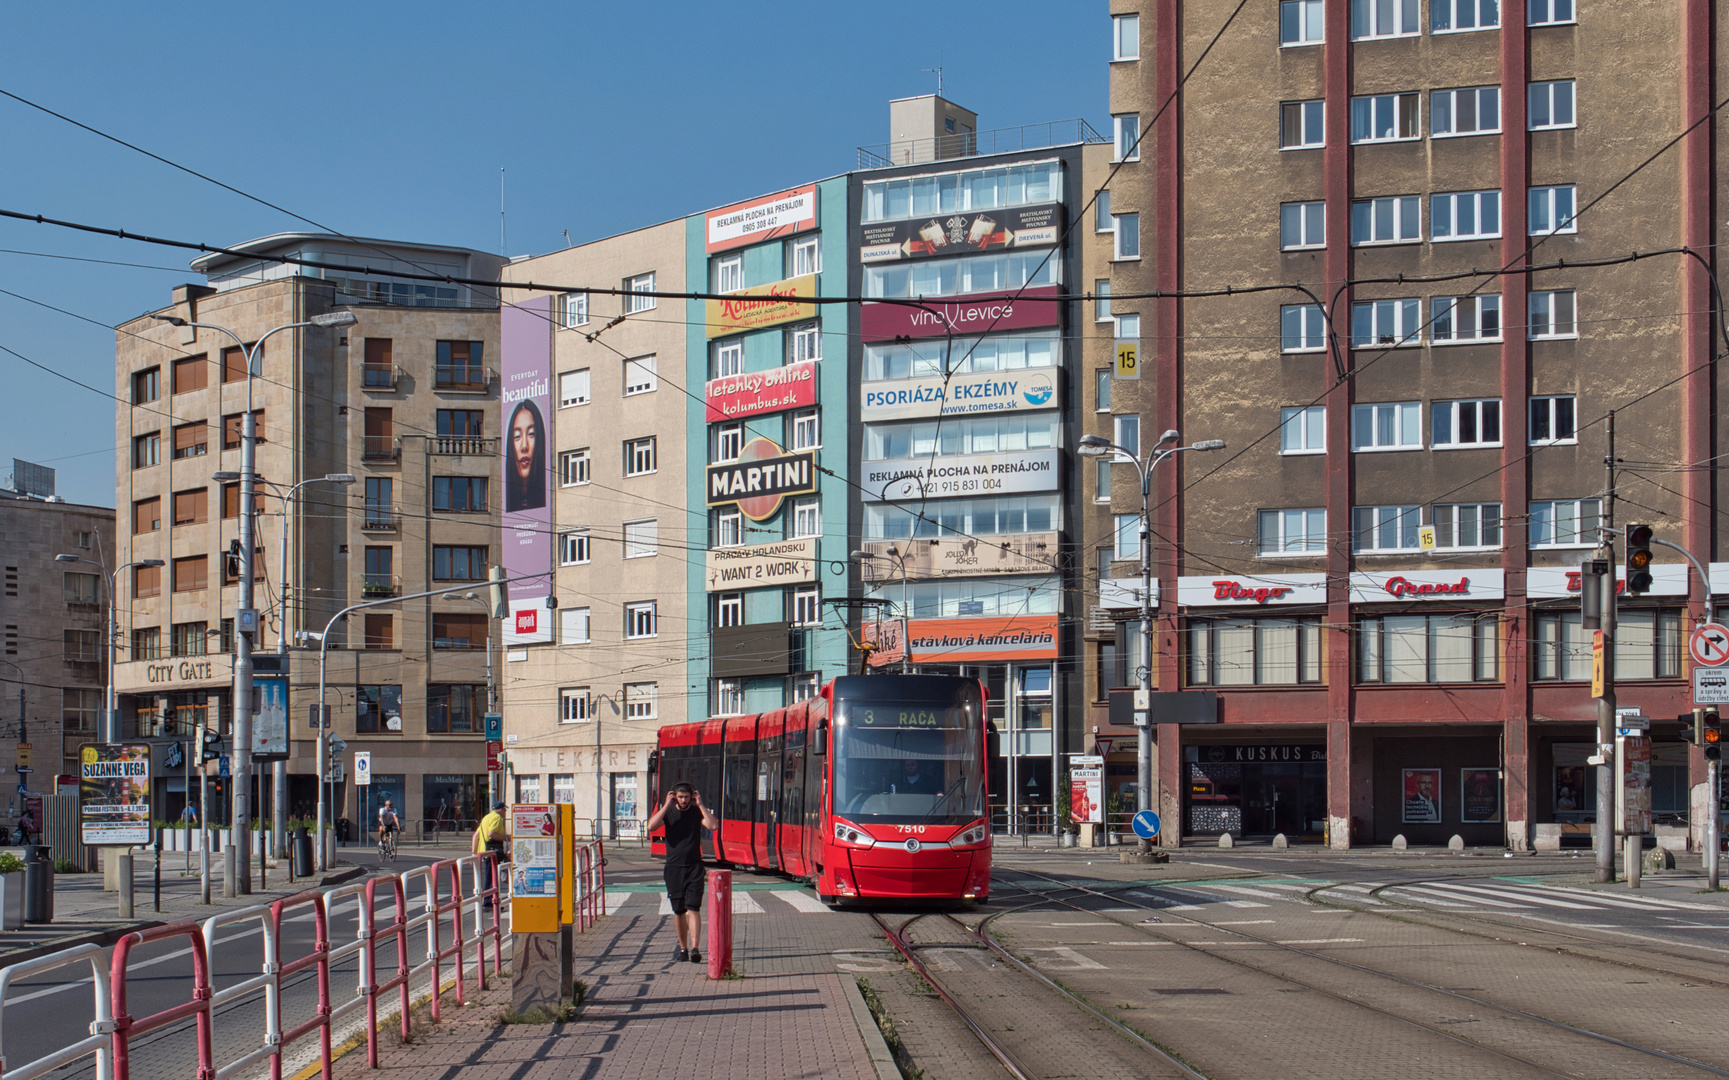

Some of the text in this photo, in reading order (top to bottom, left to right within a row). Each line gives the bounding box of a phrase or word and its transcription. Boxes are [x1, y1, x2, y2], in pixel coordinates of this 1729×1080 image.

[717, 199, 803, 228] REKLAMNÁ PLOCHA NA PRENÁJOM
[1020, 208, 1053, 217] BRATISLAVSKÝ
[743, 217, 777, 232] 0905 308 447
[864, 226, 896, 235] BRATISLAVSKÝ
[1019, 233, 1044, 241] DREVENÁ
[864, 249, 890, 257] DUNAJSKÁ
[720, 285, 796, 320] Kolumbus
[720, 310, 800, 331] www.kolumbus.sk
[910, 310, 944, 326] víno
[1119, 351, 1136, 368] 15
[511, 370, 538, 381] EVERYDAY
[709, 366, 811, 397] letenky online
[502, 377, 548, 403] beautiful
[867, 379, 1018, 406] PSORIÁZA, EKZÉMY
[723, 390, 797, 415] kolumbus.sk
[942, 400, 1018, 413] www.tomesa.sk
[712, 460, 808, 497] MARTINI
[870, 460, 1050, 482] REKLAMNÁ PLOCHA NA PRENÁJOM
[916, 479, 1002, 492] +421 915 831 004
[1422, 533, 1433, 545] 15
[752, 543, 805, 556] HOLANDSKU
[721, 561, 799, 581] WANT 2 WORK
[1212, 581, 1291, 603] Bingo
[1385, 576, 1468, 597] Grand
[519, 613, 534, 630] aupark
[911, 633, 974, 648] stávková
[978, 632, 1052, 645] kancelária
[148, 661, 211, 682] CITY GATE
[864, 710, 936, 725] 3 RAČA
[168, 742, 178, 756] FIT
[1236, 746, 1301, 760] KUSKUS
[84, 762, 146, 777] SUZANNE VEGA
[898, 825, 925, 833] 7510
